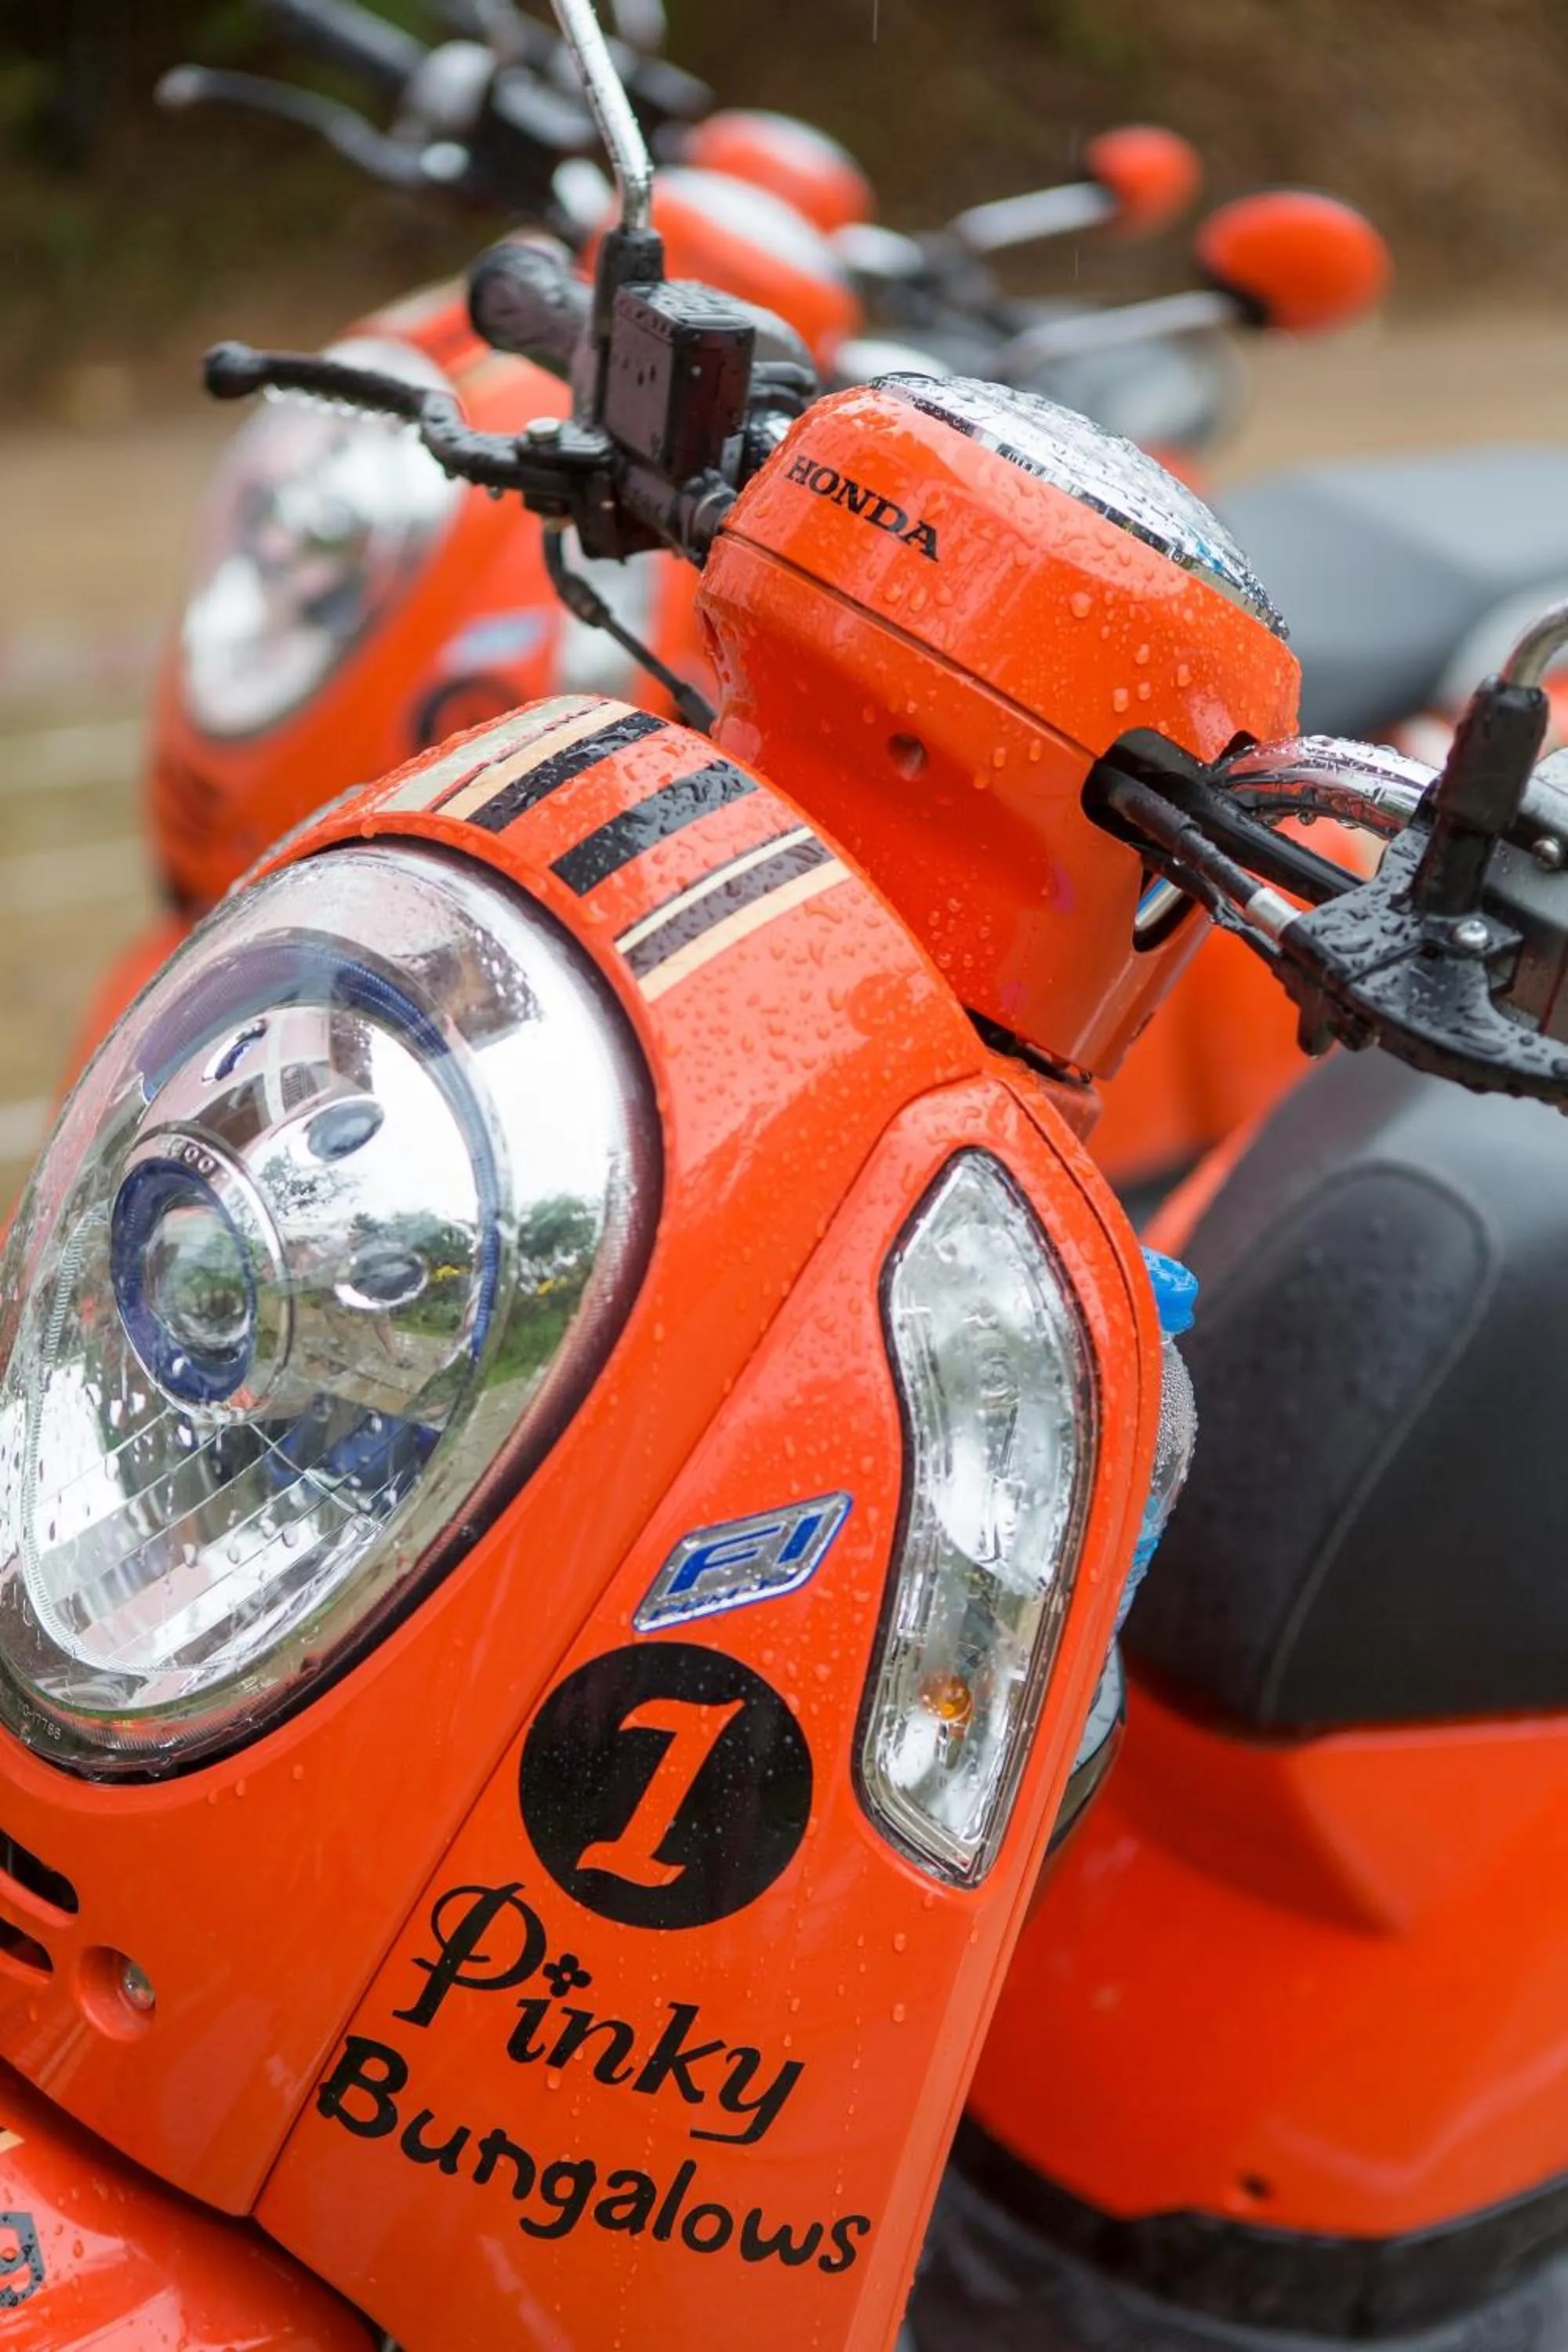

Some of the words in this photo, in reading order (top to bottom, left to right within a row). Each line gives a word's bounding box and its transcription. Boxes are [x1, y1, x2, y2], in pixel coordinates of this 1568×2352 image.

[784, 455, 939, 563] HONDA
[665, 1513, 825, 1595] FI
[575, 1697, 746, 1888] 1
[392, 1882, 805, 2144] Pinky
[316, 2035, 871, 2274] Bungalows
